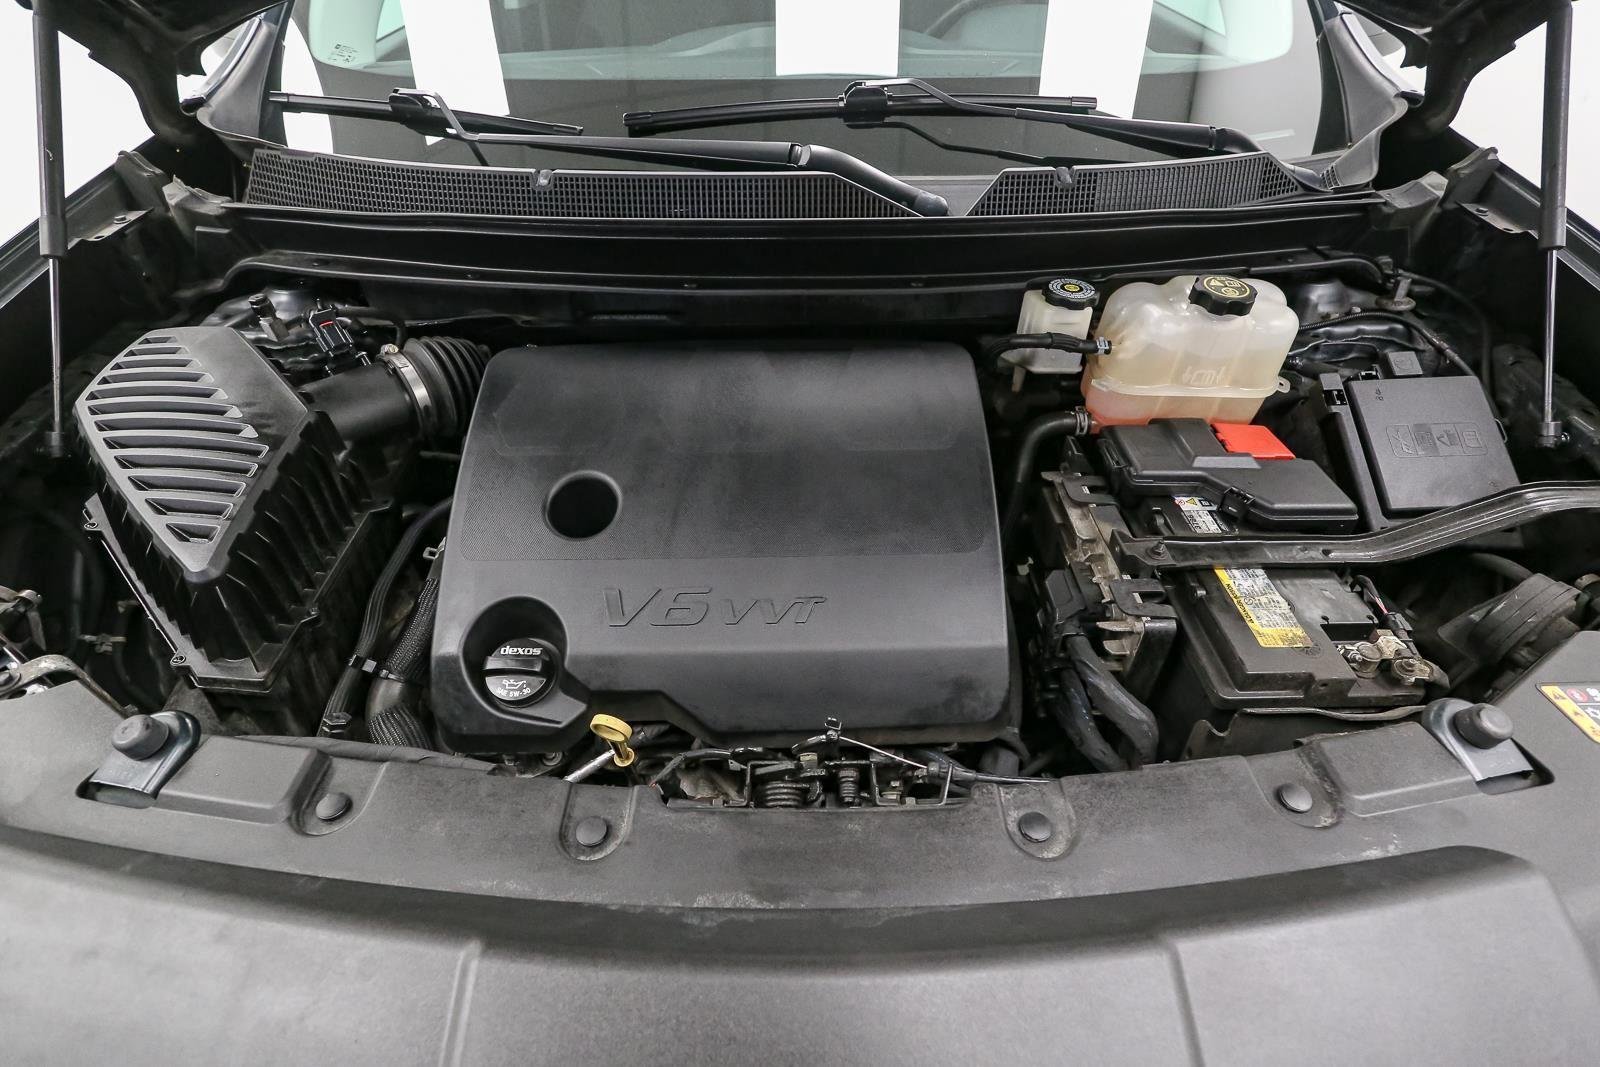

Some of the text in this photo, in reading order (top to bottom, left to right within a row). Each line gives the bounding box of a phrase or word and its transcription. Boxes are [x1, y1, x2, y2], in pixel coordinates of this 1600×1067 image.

[603, 587, 828, 627] V6 VVT
[500, 645, 544, 656] dexos
[509, 687, 531, 698] 5W-30
